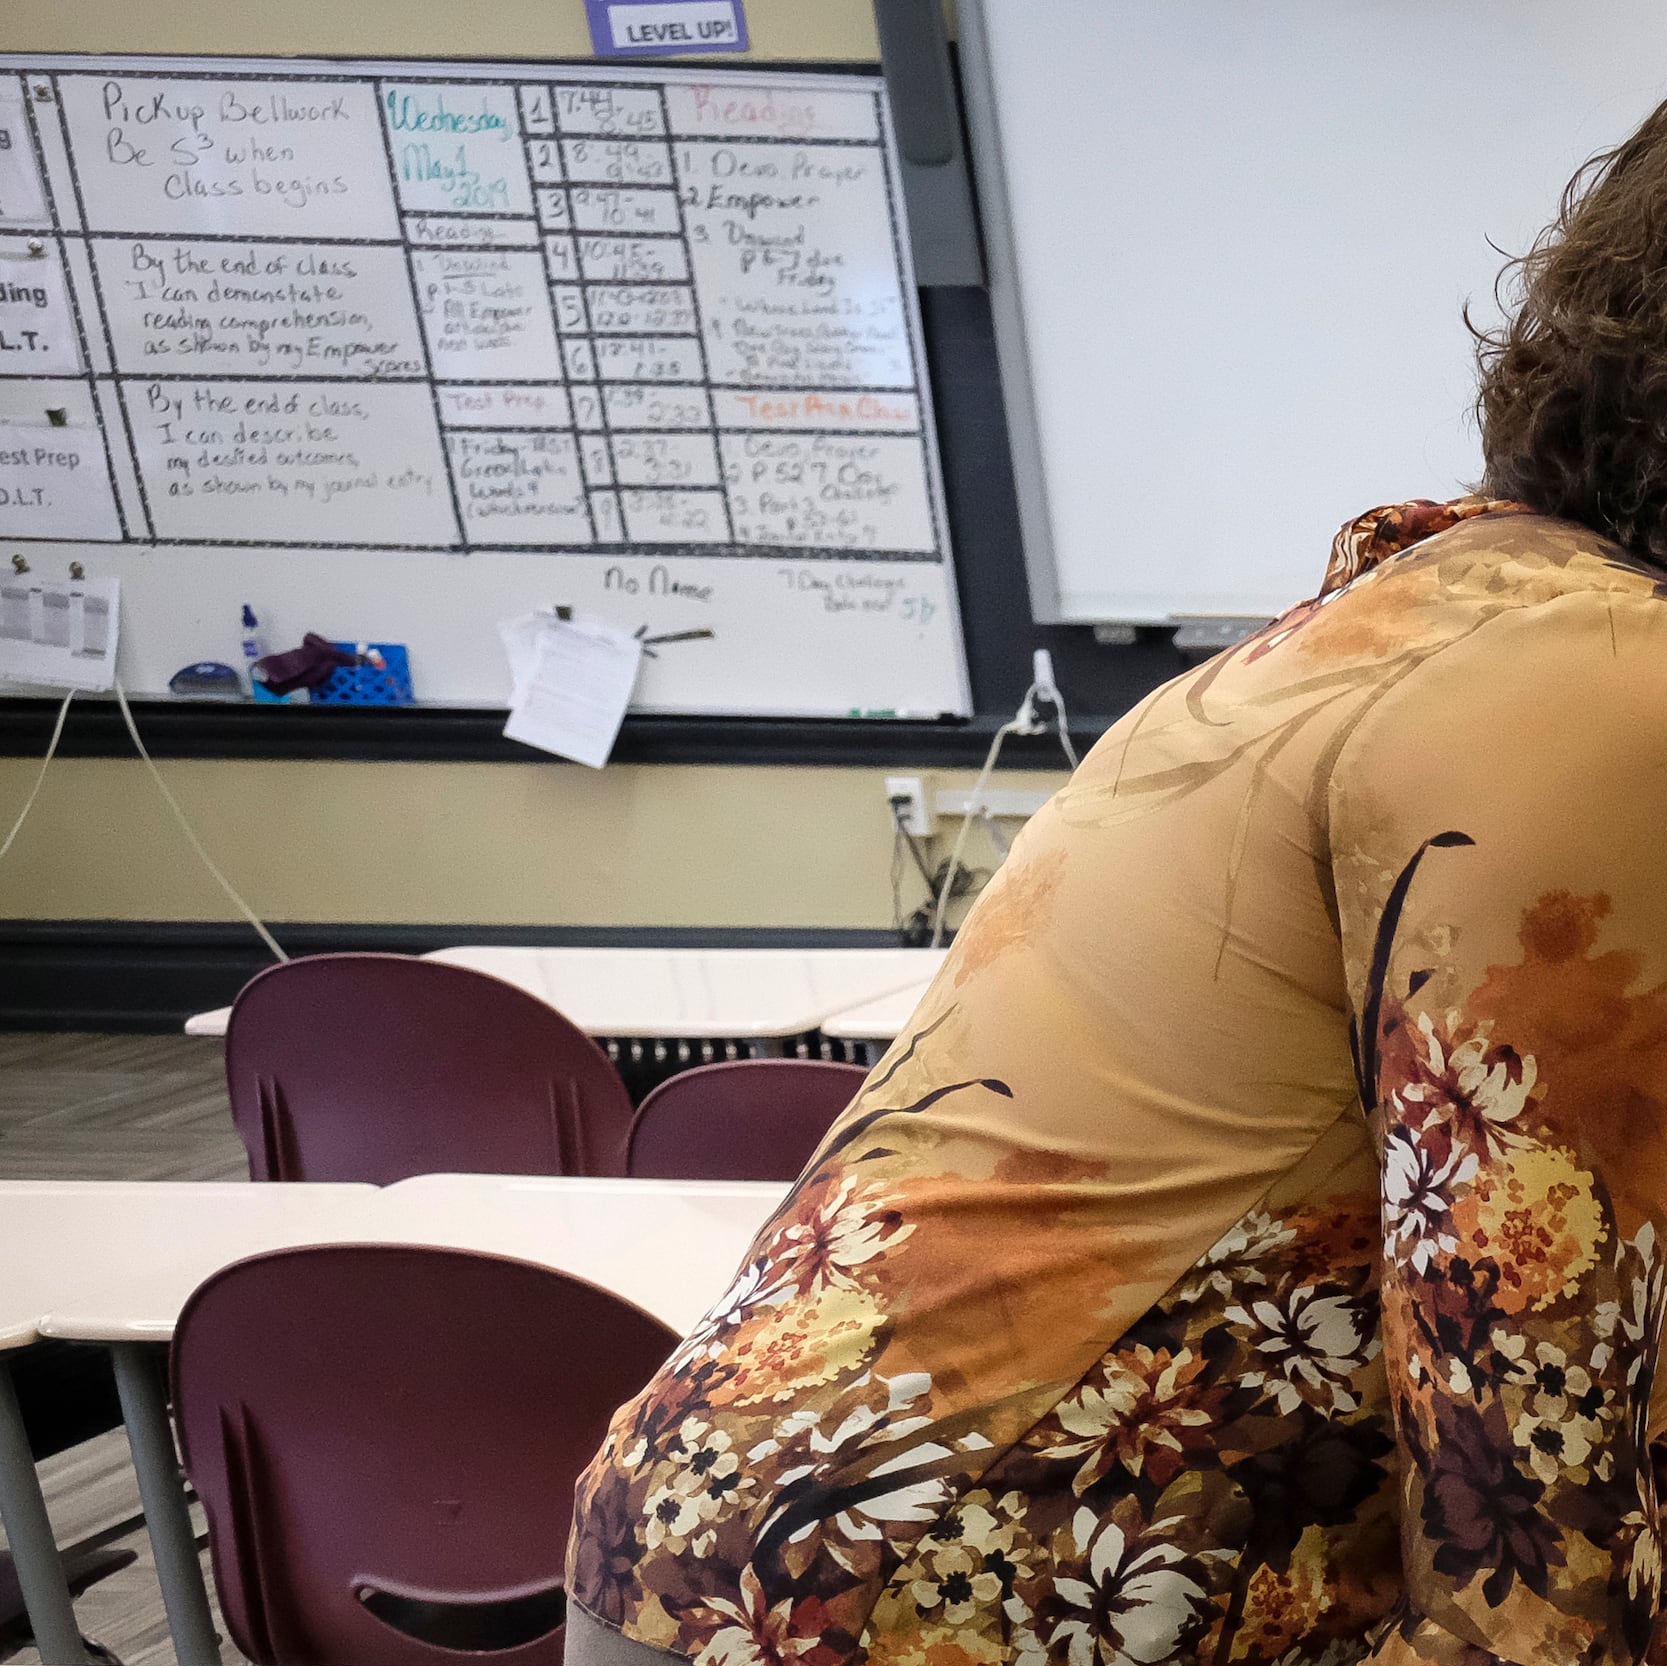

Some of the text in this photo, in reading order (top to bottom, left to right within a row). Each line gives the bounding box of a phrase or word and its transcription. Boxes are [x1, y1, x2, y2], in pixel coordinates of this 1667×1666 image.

[626, 19, 733, 43] LEVEL UP!
[219, 90, 350, 124] Bellwork
[106, 126, 154, 166] Be
[225, 136, 294, 165] when
[253, 168, 349, 208] begins
[707, 184, 821, 220] Empower
[131, 243, 166, 287] By
[173, 247, 216, 275] the
[220, 250, 263, 278] end
[264, 253, 289, 275] of
[552, 241, 569, 270] 4
[162, 285, 199, 302] can
[143, 306, 213, 342] reading
[248, 333, 275, 366] by
[147, 383, 184, 421] By
[194, 386, 238, 416] the
[244, 392, 282, 416] end
[156, 421, 175, 445] I
[185, 428, 225, 445] can
[34, 448, 80, 468] Prep
